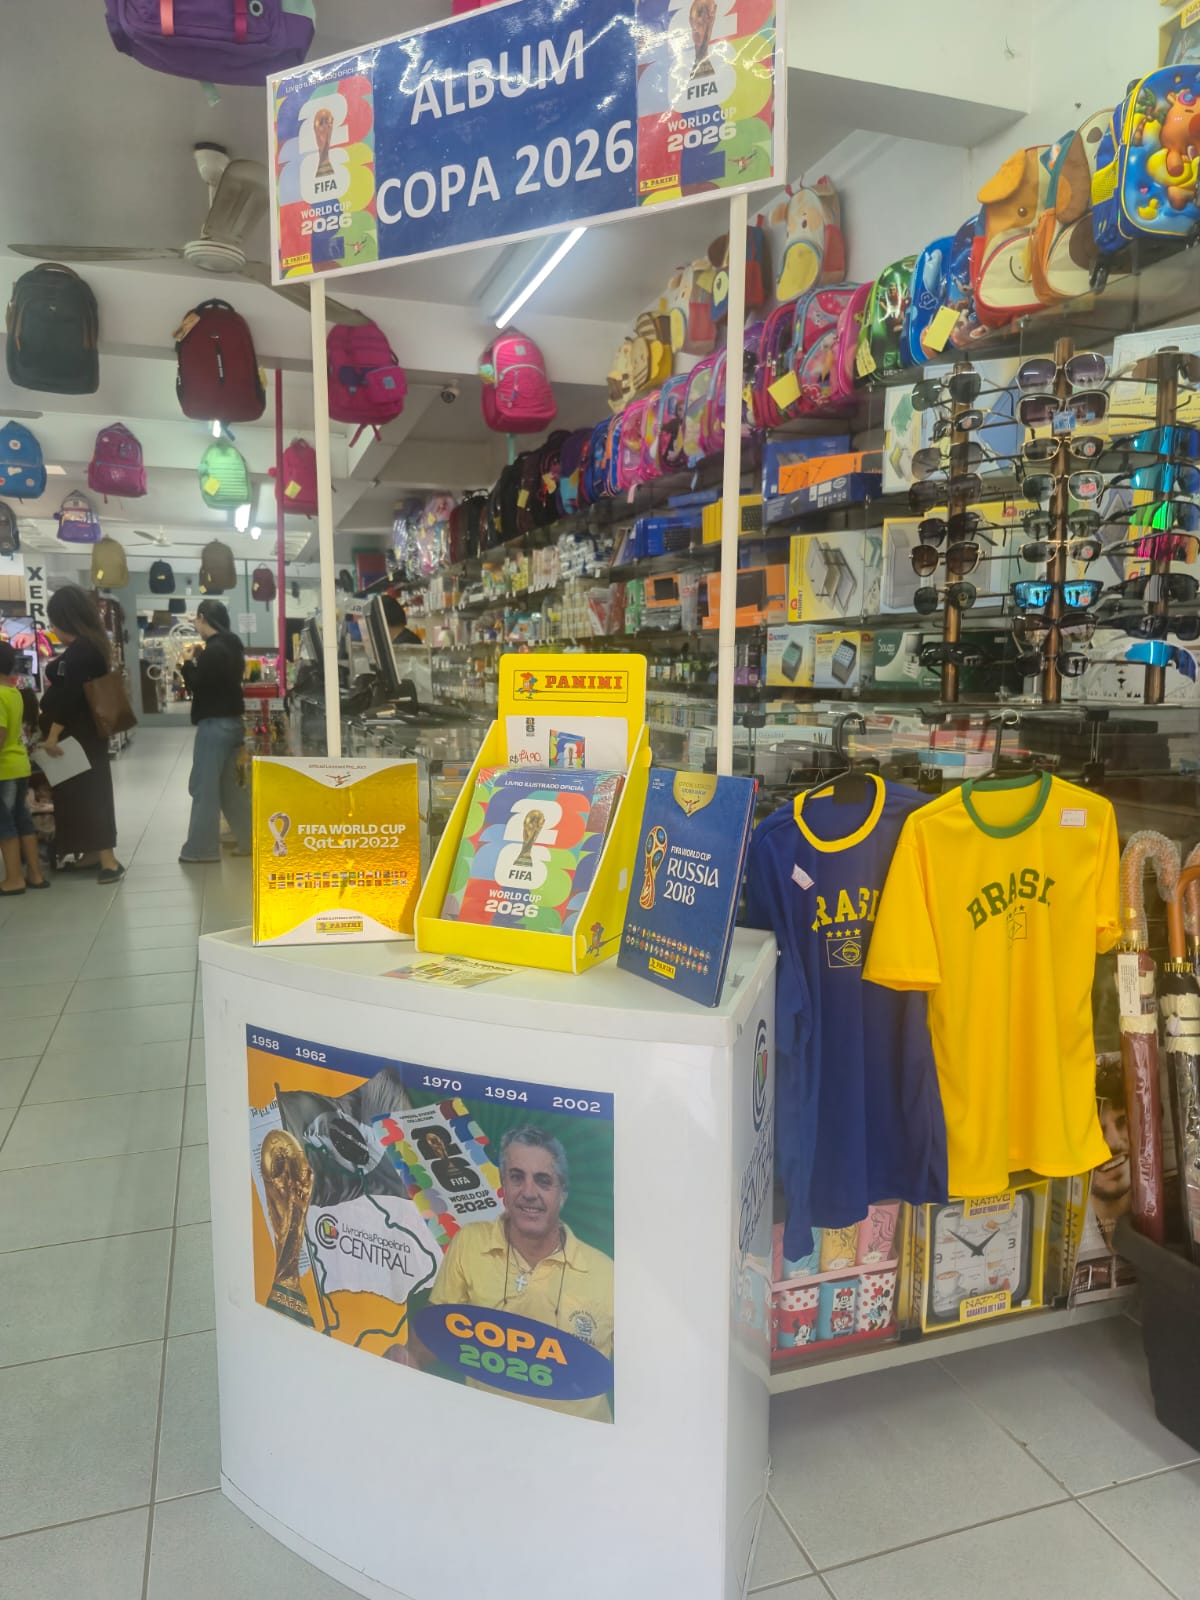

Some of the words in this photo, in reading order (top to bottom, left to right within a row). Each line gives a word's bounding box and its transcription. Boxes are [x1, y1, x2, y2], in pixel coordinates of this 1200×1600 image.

[410, 29, 585, 126] ÁLBUM
[687, 81, 718, 100] FIFA
[667, 114, 711, 132] WORLD
[712, 107, 737, 122] CUP
[667, 122, 737, 152] 2026
[375, 155, 501, 226] COPA
[515, 120, 634, 195] 2026
[650, 176, 677, 186] PANINI
[314, 180, 337, 194] FIFA
[301, 206, 333, 219] WORLD
[333, 200, 352, 212] CUP
[301, 213, 352, 235] 2026
[545, 675, 623, 689] PANINI
[298, 825, 326, 835] FIFA
[329, 824, 377, 835] WORLD
[380, 823, 406, 834] CUP
[359, 836, 399, 848] 2022
[671, 845, 682, 855] FIFA
[682, 848, 701, 859] WORLD
[700, 852, 711, 861] CUP
[508, 869, 532, 881] FIFA
[667, 857, 719, 888] RUSSIA
[489, 889, 522, 900] WORLD
[523, 893, 542, 903] CUP
[663, 880, 695, 905] 2018
[966, 868, 1056, 930] BRASI
[484, 899, 539, 917] 2026
[252, 1034, 280, 1050] 1958
[295, 1047, 327, 1063] 1962
[423, 1075, 462, 1092] 1970
[484, 1086, 528, 1102] 1994
[552, 1097, 601, 1113] 2002
[450, 1175, 471, 1187] FIFA
[448, 1192, 475, 1203] WORLD
[475, 1189, 490, 1199] CUP
[454, 1197, 498, 1214] 2026
[1008, 1238, 1016, 1249] 3
[339, 1235, 415, 1277] CENTRAL
[966, 1292, 1006, 1308] NATIVO
[445, 1312, 568, 1365] COPA
[459, 1344, 553, 1387] 2026
